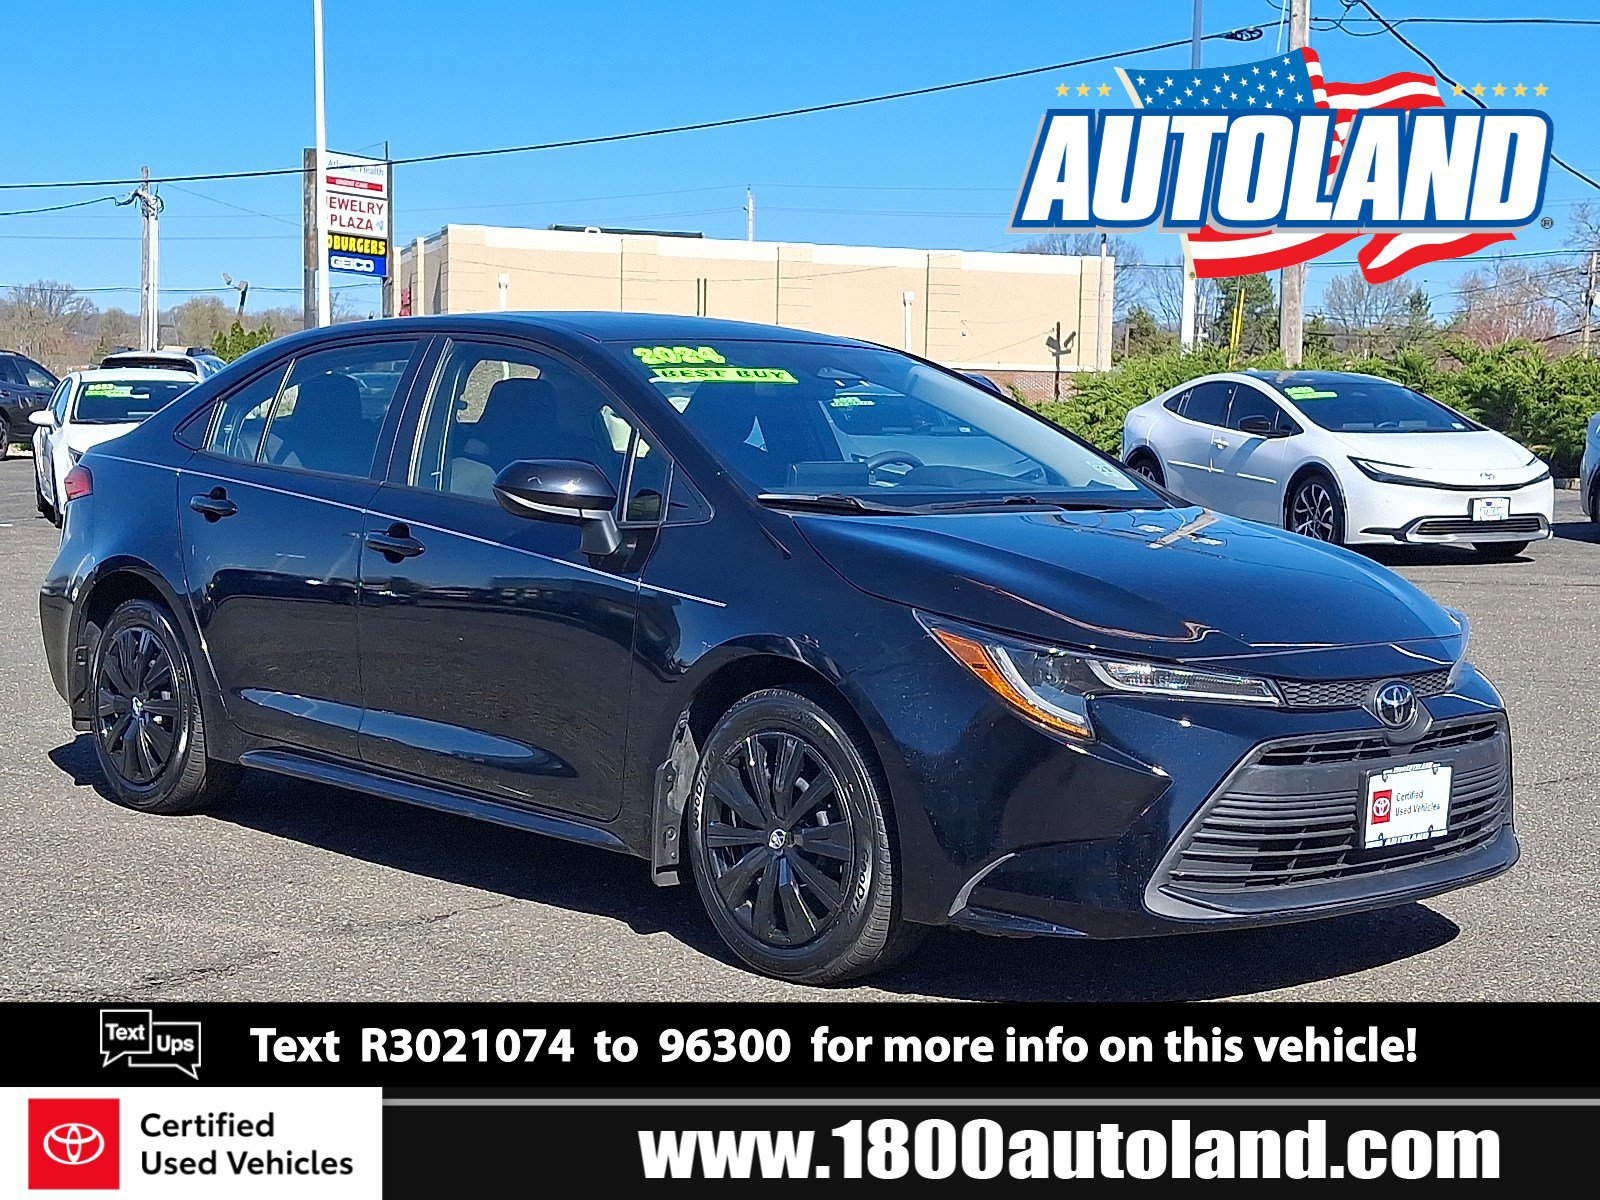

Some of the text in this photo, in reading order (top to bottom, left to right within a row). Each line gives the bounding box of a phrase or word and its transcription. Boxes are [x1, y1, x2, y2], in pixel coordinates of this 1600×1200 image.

[326, 196, 384, 215] EWELRY
[330, 214, 373, 231] PLAZA
[331, 256, 374, 272] GEICO
[633, 346, 726, 365] 2024
[660, 369, 785, 379] BEST BUY
[1396, 789, 1424, 802] Certified
[1395, 802, 1441, 817] Used Vehicles
